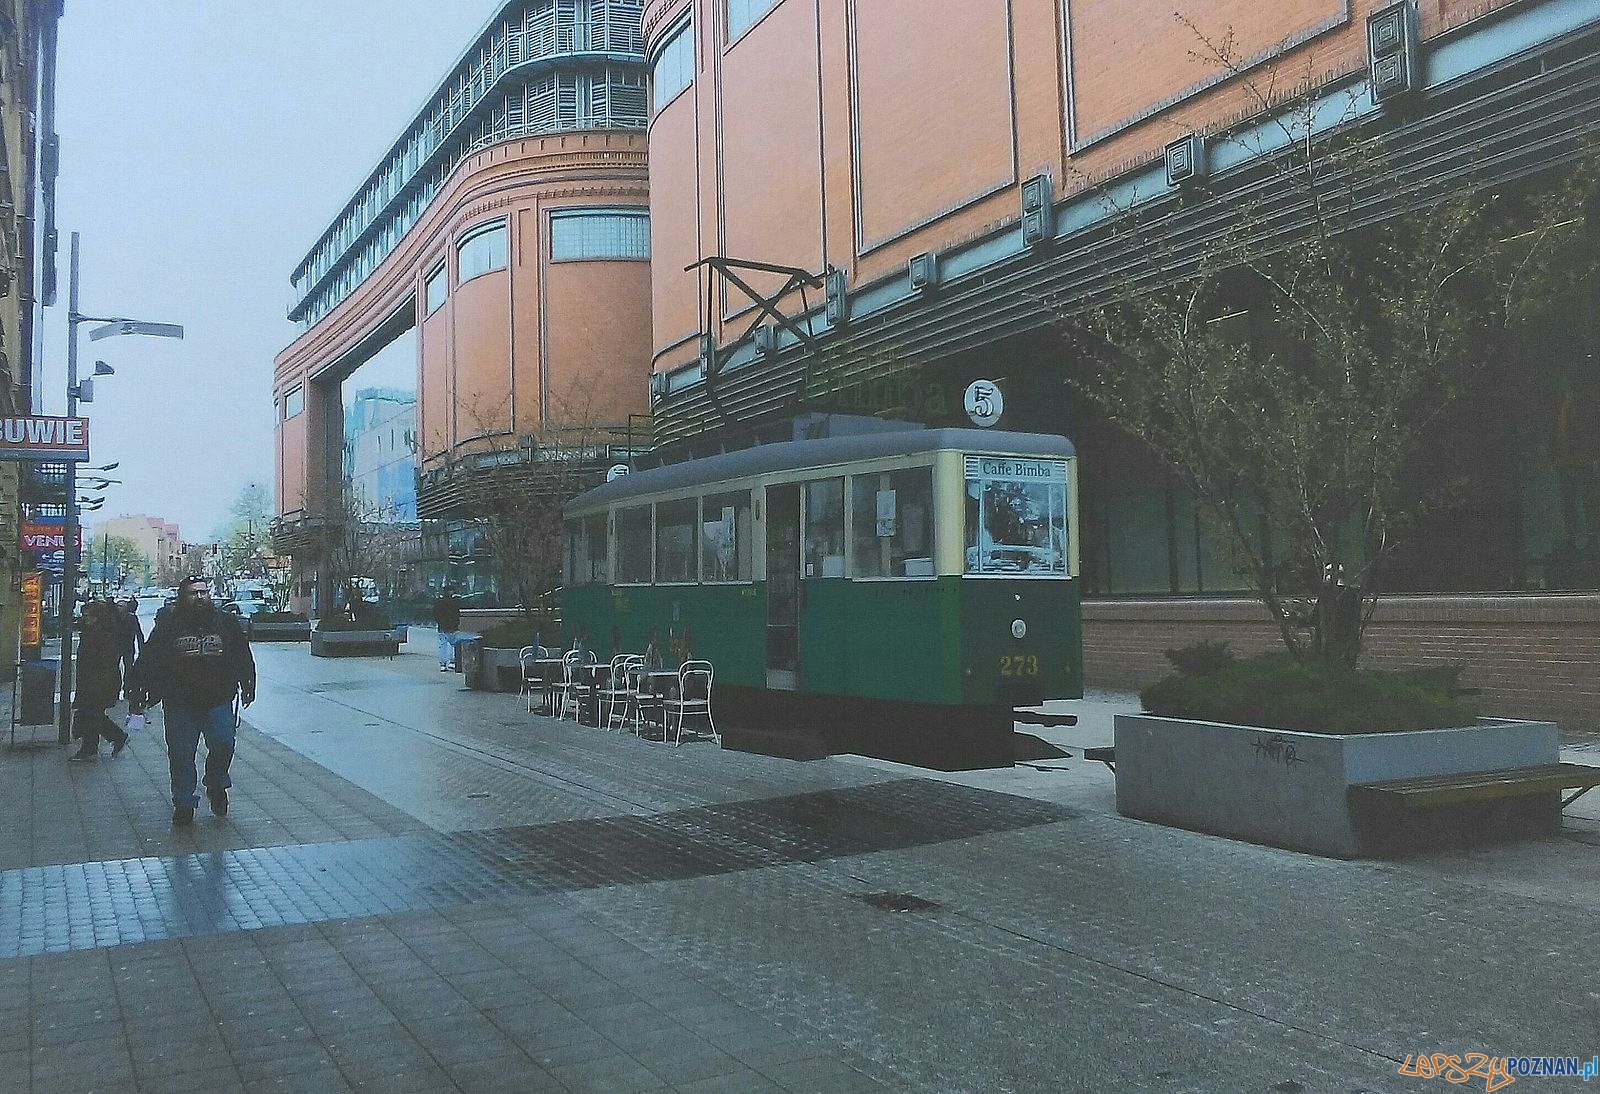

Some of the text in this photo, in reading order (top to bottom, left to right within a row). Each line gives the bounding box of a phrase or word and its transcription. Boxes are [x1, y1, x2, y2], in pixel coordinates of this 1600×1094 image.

[975, 386, 994, 417] 5
[0, 419, 83, 445] UWIE
[982, 462, 1051, 478] Caffe Bimba
[1000, 655, 1039, 676] 273
